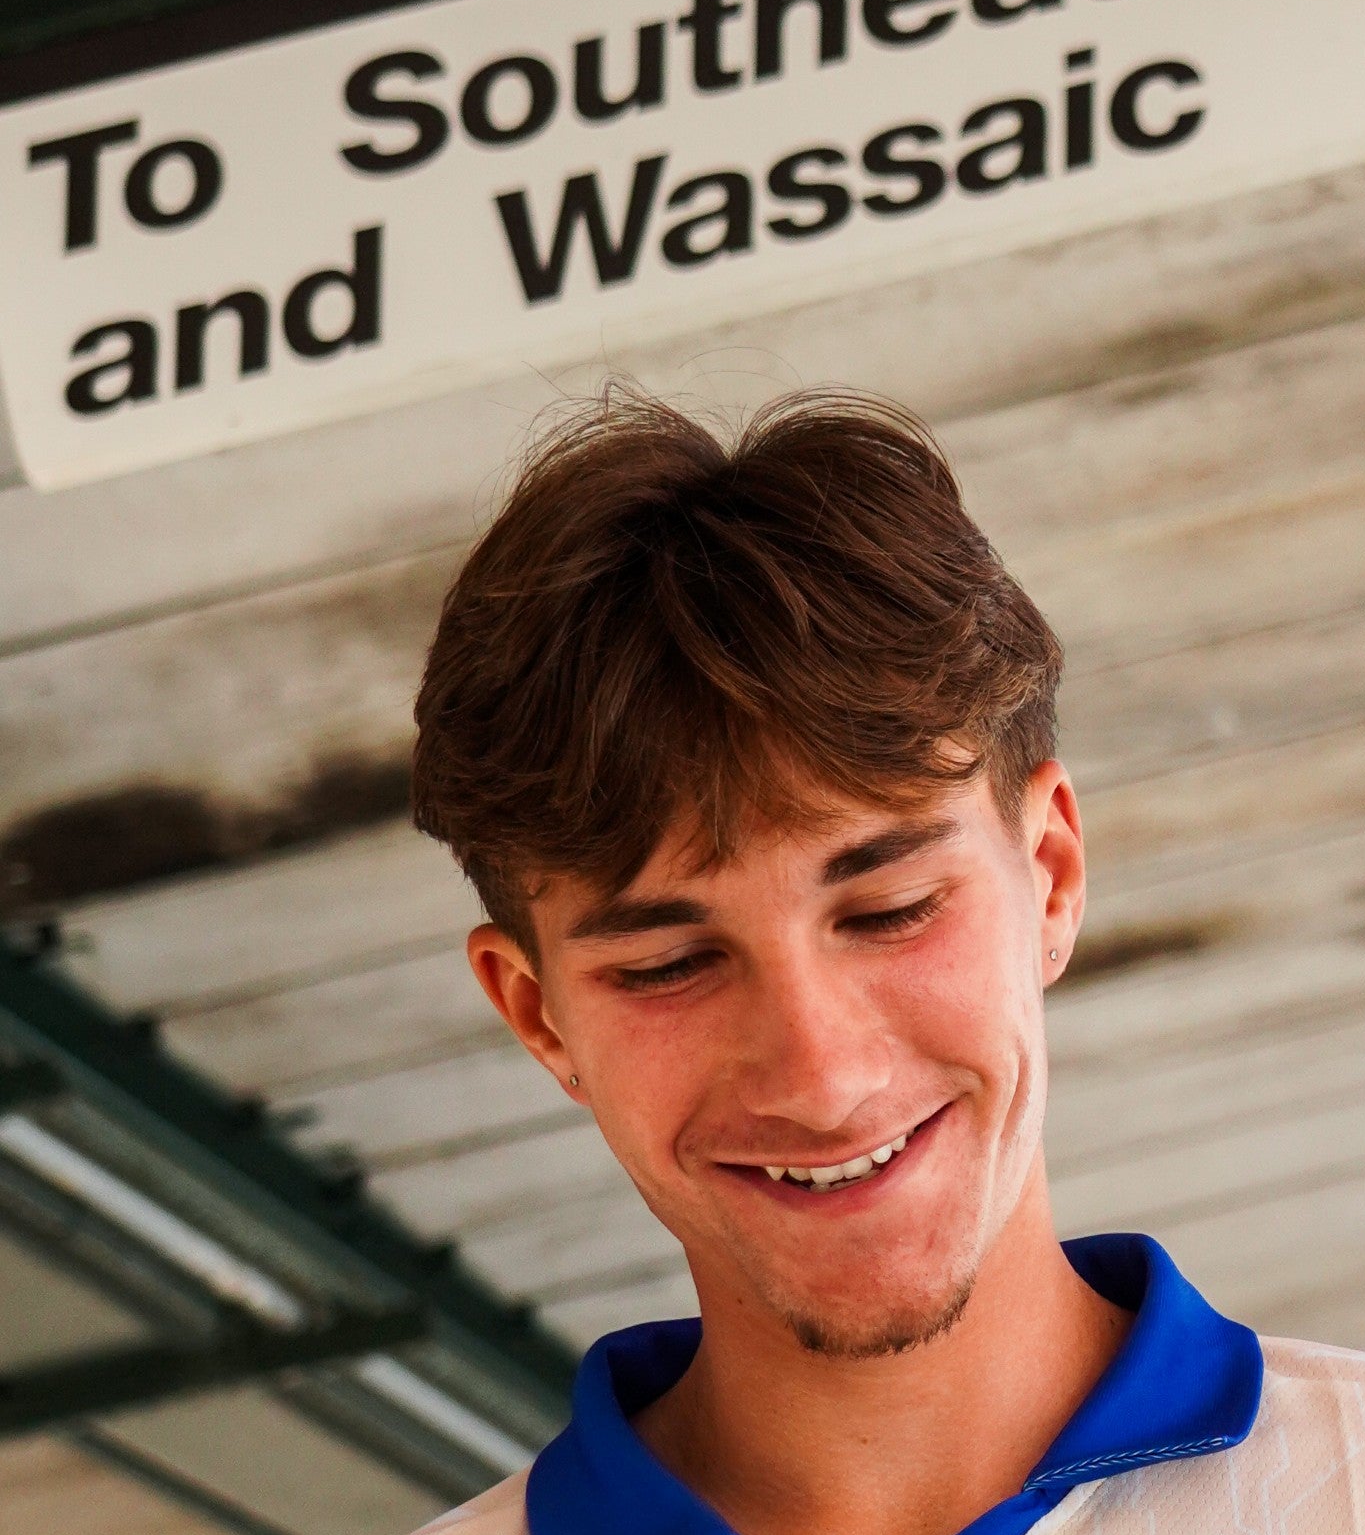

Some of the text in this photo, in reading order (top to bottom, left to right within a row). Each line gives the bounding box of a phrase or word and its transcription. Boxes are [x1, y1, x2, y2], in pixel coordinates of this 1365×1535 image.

[28, 120, 223, 251] To
[65, 48, 1204, 416] and Wassaic
